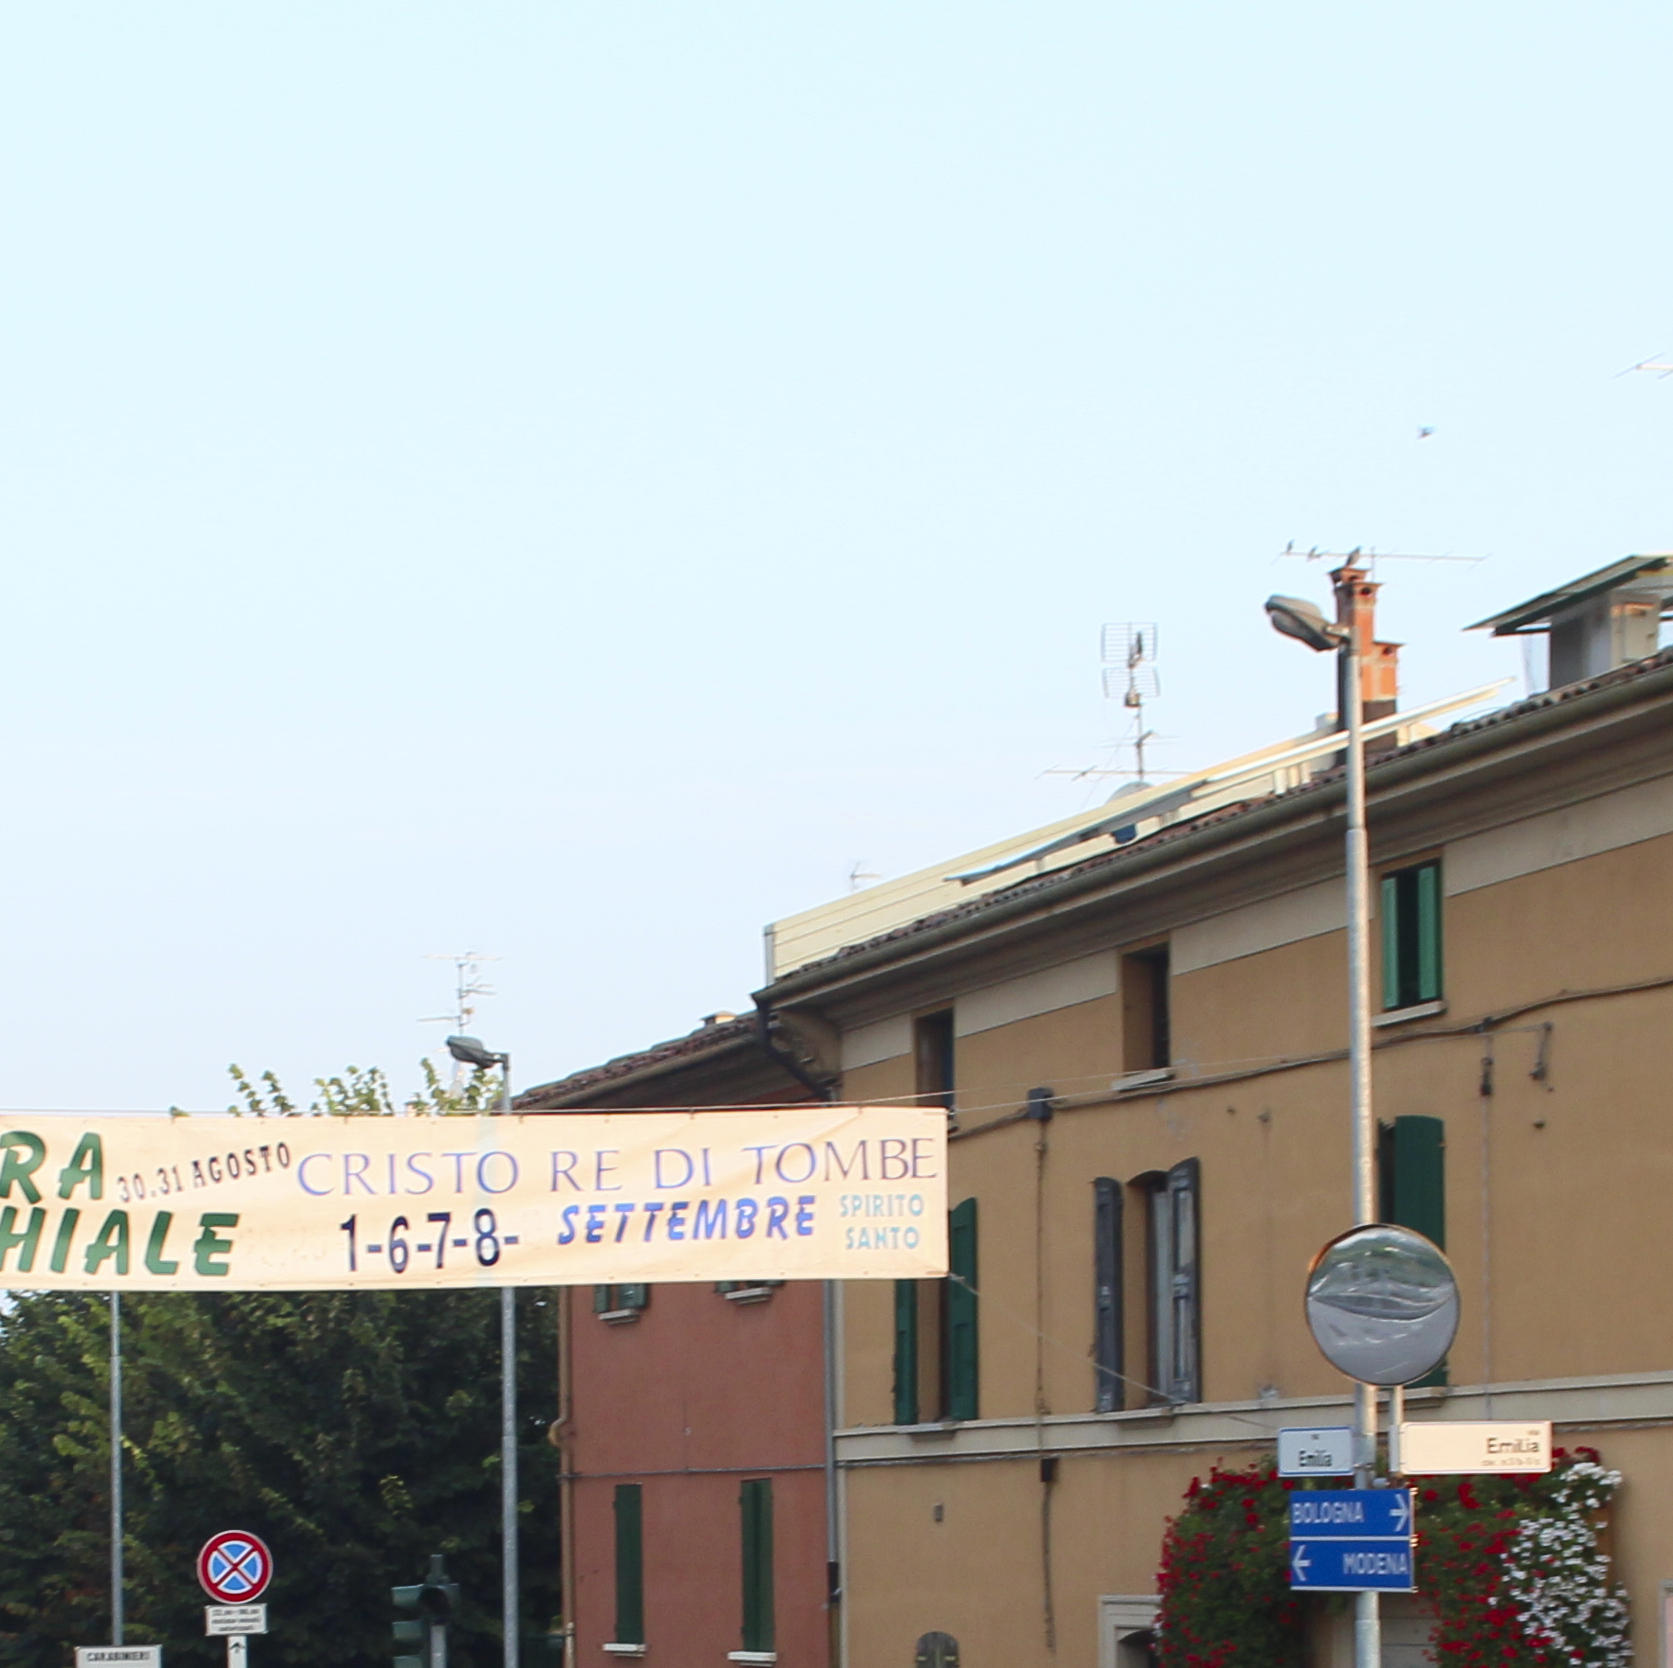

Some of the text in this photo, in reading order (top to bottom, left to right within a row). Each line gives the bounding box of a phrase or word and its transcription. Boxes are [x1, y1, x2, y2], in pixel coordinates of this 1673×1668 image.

[190, 1141, 291, 1189] AGOSTO
[297, 1138, 939, 1196] CRISTO RE DI TOMBE
[839, 1193, 924, 1219] SPIRITO
[557, 1195, 816, 1246] SETTEMBRE
[845, 1225, 920, 1250] SANTO
[1298, 1449, 1332, 1468] Emilia
[1486, 1437, 1540, 1455] Emilia
[1292, 1501, 1365, 1525] BOLOGNA
[1343, 1552, 1409, 1576] MODENA
